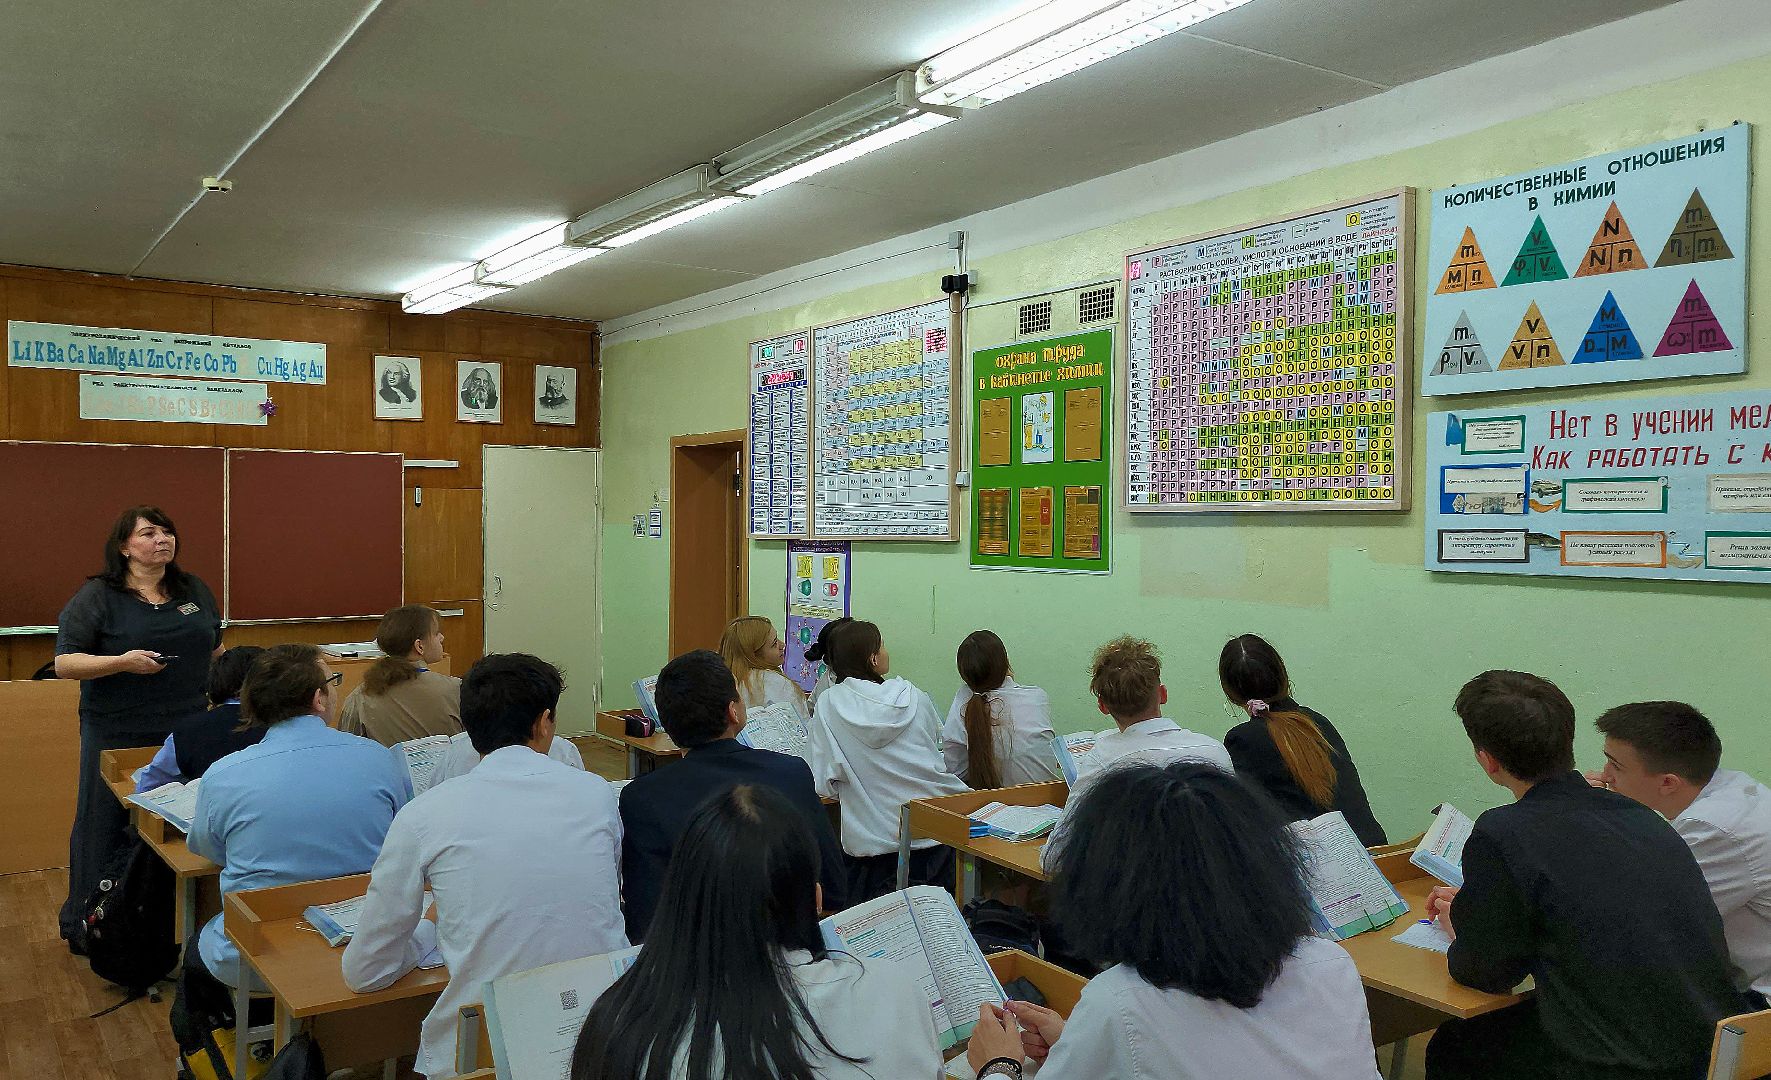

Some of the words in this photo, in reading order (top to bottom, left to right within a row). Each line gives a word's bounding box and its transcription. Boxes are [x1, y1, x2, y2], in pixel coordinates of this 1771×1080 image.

[1444, 166, 1588, 209] КОЛИЧЕСТВЕННЫЕ
[1607, 136, 1725, 176] ОТНОШЕНИЯ
[1528, 197, 1539, 211] В
[1554, 181, 1616, 206] ХИМИИ
[1160, 262, 1214, 277] РАСТВОРИМОСТЬ
[1279, 237, 1325, 254] ОСНОВАНИЙ
[1336, 232, 1357, 243] ВОДЕ
[47, 342, 64, 363] Ba
[68, 344, 84, 363] Ca
[185, 352, 200, 370] Fe
[204, 353, 218, 372] Co
[222, 355, 236, 373] Pb
[258, 357, 272, 376] Cu
[1550, 410, 1591, 439] Нет
[1632, 408, 1714, 440] учении
